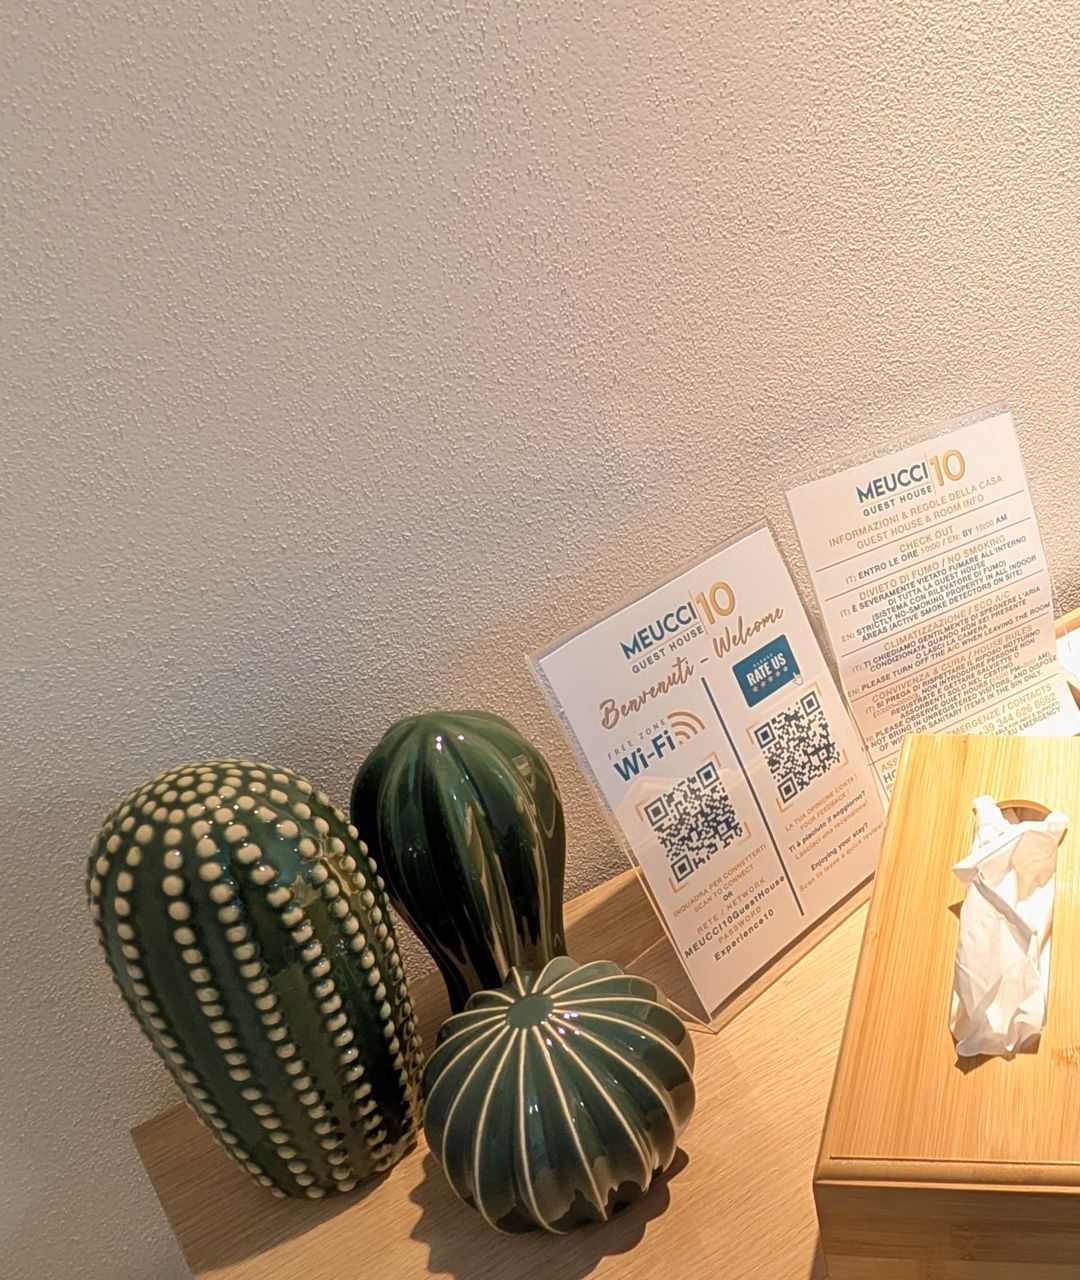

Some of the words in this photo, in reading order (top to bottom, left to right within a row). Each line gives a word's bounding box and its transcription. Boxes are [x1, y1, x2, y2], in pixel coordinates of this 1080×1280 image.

[855, 462, 928, 503] MEUCCI
[929, 449, 965, 486] 10
[828, 514, 898, 547] INFORMAZIONI
[909, 495, 946, 516] REGOLE
[948, 484, 977, 501] DELLA
[978, 474, 1003, 489] CASA
[856, 530, 887, 549] GUEST
[889, 516, 923, 536] HOUSE
[933, 502, 961, 519] ROOM
[962, 493, 984, 508] INFO
[862, 498, 895, 516] GUEST
[898, 484, 932, 503] HOUSE
[857, 562, 886, 579] ENTRO
[887, 556, 899, 567] LE
[900, 548, 918, 561] ORE
[961, 527, 972, 537] BY
[995, 513, 1007, 524] AM
[898, 533, 933, 552] CHECK
[934, 524, 953, 539] OUT
[858, 578, 897, 600] DIVIETO
[898, 572, 909, 584] DI
[911, 561, 939, 579] FUMO
[946, 552, 961, 564] NO
[962, 534, 1005, 557] SMOKING
[858, 580, 915, 609] SEVERAMENTE
[916, 568, 947, 585] VIETATO
[948, 554, 978, 572] FUMARE
[887, 597, 896, 606] DI
[897, 587, 922, 601] TUTTA
[922, 582, 933, 591] LA
[933, 570, 958, 586] GUEST
[959, 559, 985, 575] HOUSE
[909, 592, 926, 605] CON
[927, 573, 972, 597] RILEVATORE
[973, 569, 982, 578] DI
[695, 581, 735, 624] 10
[855, 615, 892, 636] STRICTLY
[894, 593, 944, 619] NO-SMOKING
[945, 576, 983, 598] PROPERTY
[984, 572, 993, 581] IN
[994, 567, 1008, 577] ALL
[1008, 554, 1037, 571] INDOOR
[861, 625, 888, 642] AREAS
[919, 600, 947, 617] SMOKE
[948, 581, 991, 605] DETECTORS
[992, 576, 1004, 585] ON
[620, 601, 696, 659] MEUCCI
[631, 647, 665, 673] GUEST
[668, 625, 704, 651] HOUSE
[861, 673, 890, 691] PLEASE
[891, 663, 913, 677] TURN
[914, 655, 928, 667] OFF
[930, 648, 945, 660] THE
[960, 632, 982, 646] WHEN
[983, 618, 1013, 636] LEAVING
[1014, 611, 1028, 622] THE
[1029, 601, 1050, 615] ROOM
[869, 644, 926, 672] CONDIZIONATA
[927, 628, 959, 647] QUANDO
[960, 621, 976, 632] NON
[977, 614, 989, 625] SEI
[990, 598, 1026, 619] PRESENTE
[872, 640, 916, 663] CHIEDIAMO
[917, 616, 968, 643] GENTILMENTE
[969, 612, 978, 621] DI
[883, 609, 965, 650] CLIMATIZZAZIONE
[973, 597, 992, 612] ECO
[922, 641, 945, 656] LASCI
[945, 637, 956, 646] LA
[956, 623, 987, 641] CAMERA
[599, 657, 693, 729] Benvenuti
[712, 608, 783, 658] Welcome
[746, 661, 772, 686] RATE
[770, 652, 786, 669] US
[871, 671, 930, 702] CONVIVENZA
[940, 655, 966, 671] CURA
[973, 636, 1003, 656] HOUSE
[1004, 624, 1032, 642] RULES
[885, 688, 911, 704] PREGA
[921, 662, 965, 687] RISPETTARE
[974, 646, 1002, 663] RIPOSO
[1002, 628, 1040, 651] NOTTURNO
[890, 690, 935, 716] REGISTRATE
[943, 671, 978, 691] GETTARE
[977, 654, 1012, 675] SALVIETTE
[920, 682, 939, 696] NON
[986, 644, 1018, 664] PERSONE
[1019, 637, 1035, 648] NON
[870, 735, 886, 748] NOT
[888, 723, 912, 739] BRING
[922, 692, 977, 723] UNREGISTERED
[1013, 668, 1027, 680] AND
[1028, 654, 1056, 672] DISPOSE
[874, 719, 903, 738] PLEASE
[904, 703, 938, 723] OBSERVE
[939, 692, 961, 707] QUIET
[962, 680, 988, 696] HOURS
[878, 741, 888, 752] OF
[915, 724, 927, 735] OR
[927, 707, 961, 728] SANITARY
[963, 696, 985, 711] ITEMS
[995, 684, 1009, 696] THE
[900, 693, 945, 719] ASSORBENTI
[946, 683, 966, 696] SOLO
[967, 676, 981, 687] NEL
[1006, 683, 1051, 710] CONTACTS
[1018, 705, 1060, 731] EMERGENCY
[607, 739, 633, 760] FREE
[637, 718, 665, 740] ZONE
[613, 730, 675, 780] Wi-Fi
[810, 847, 837, 871] Enjoying
[837, 835, 851, 851] your
[851, 821, 868, 838] stay?
[672, 888, 708, 917] INQUADRA
[708, 876, 722, 890] PER
[722, 843, 766, 879] CONNETTERTI
[693, 895, 712, 912] SCAN
[712, 887, 722, 897] TO
[722, 863, 753, 889] CONNECT
[696, 913, 719, 934] RETE
[726, 877, 765, 911] NETWORK
[722, 890, 733, 901] OR
[684, 876, 784, 957] MEUCCI10GuestHouse
[714, 908, 773, 961] Experience10
[718, 906, 761, 943] PASSWORD
